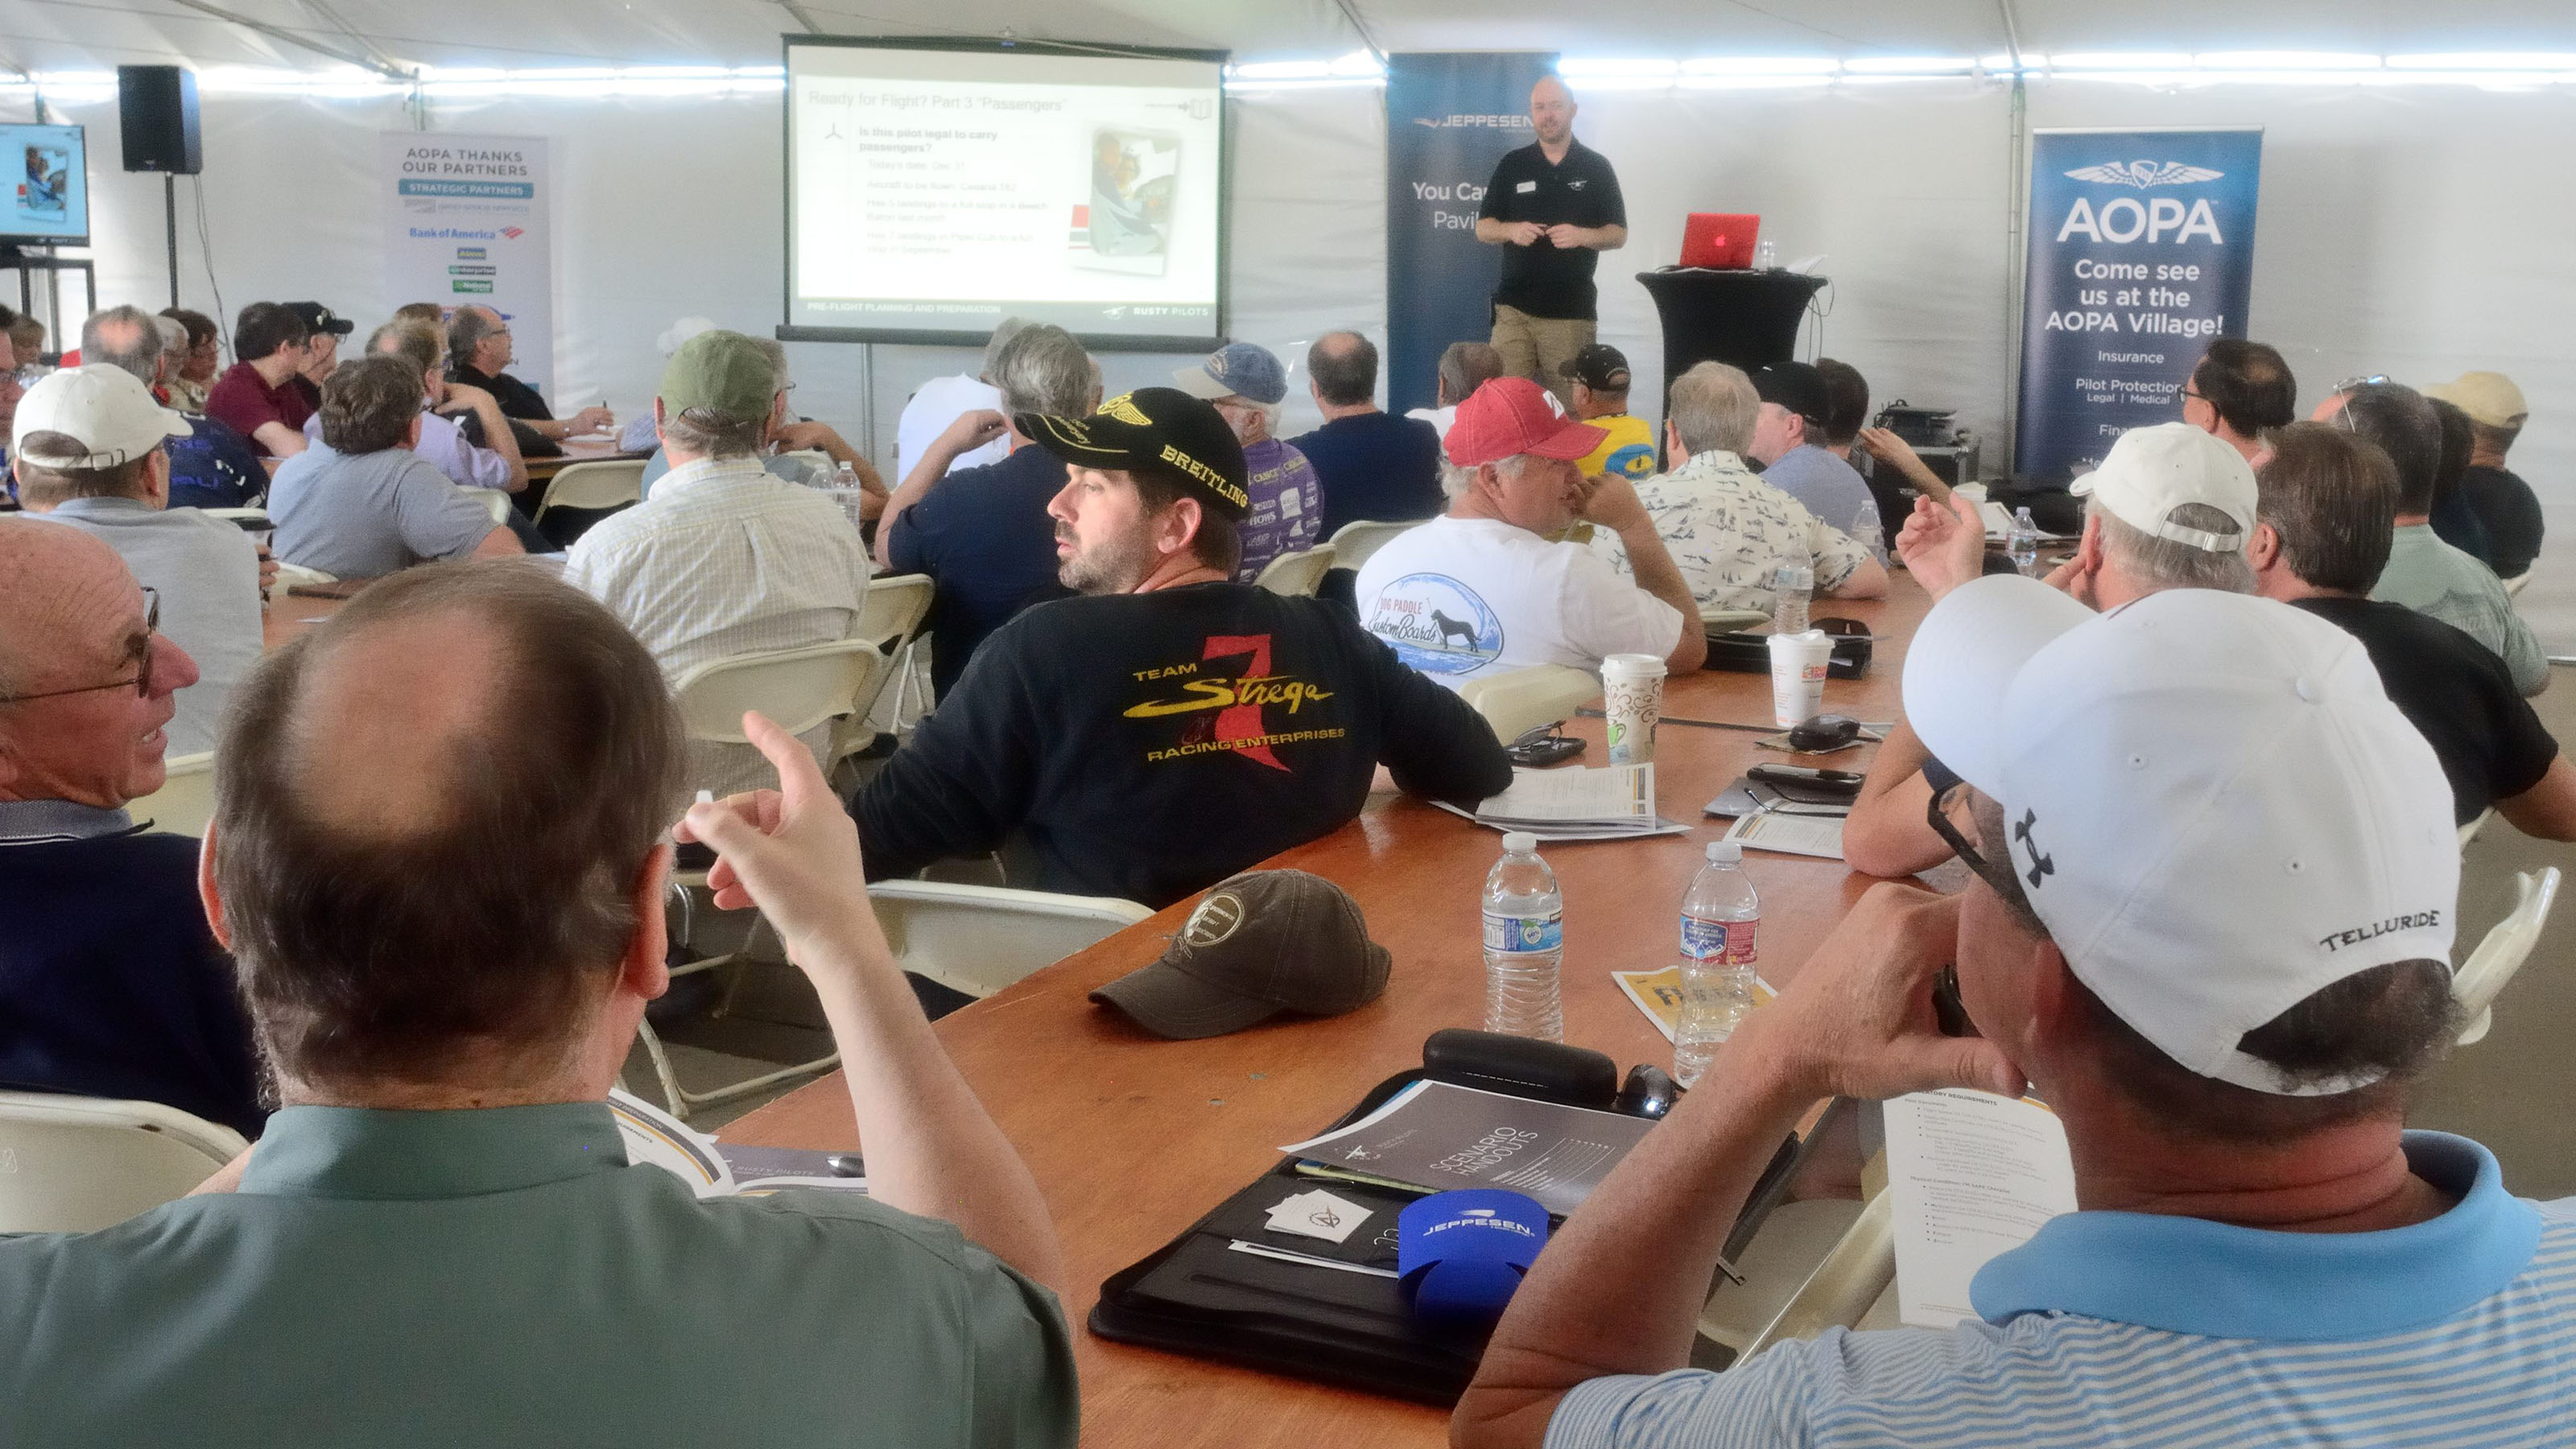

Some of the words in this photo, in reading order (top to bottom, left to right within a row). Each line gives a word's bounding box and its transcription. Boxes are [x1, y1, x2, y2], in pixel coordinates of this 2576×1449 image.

[809, 91, 854, 108] Ready
[858, 93, 876, 105] for
[881, 93, 927, 109] Flight?
[932, 95, 961, 108] Part
[964, 97, 973, 109] 3
[1442, 114, 1534, 127] JEPPESEN
[859, 126, 869, 135] Is
[873, 126, 894, 136] this
[897, 128, 922, 138] pilot
[925, 128, 952, 140] legal
[955, 130, 967, 139] to
[968, 131, 997, 141] carry
[407, 148, 451, 159] AOPA
[457, 149, 522, 163] THANKS
[859, 142, 932, 154] passengers?
[402, 162, 438, 173] OUR
[444, 163, 528, 176] PARTNERS
[409, 184, 467, 194] STRATEGIC
[470, 184, 523, 195] PARTNERS
[1413, 182, 1450, 200] You
[2057, 197, 2223, 244] AOPA
[410, 228, 436, 238] Bank
[439, 228, 450, 237] of
[451, 229, 496, 239] America
[2074, 259, 2148, 280] Come
[2156, 264, 2200, 280] see
[2080, 291, 2107, 306] us
[2116, 288, 2140, 307] at
[2149, 287, 2190, 308] the
[807, 303, 863, 313] PRE-FLIGHT
[865, 303, 913, 313] PLANNING
[914, 304, 935, 314] AND
[936, 304, 1001, 315] PREPARATION
[1133, 307, 1168, 316] RUSTY
[1172, 307, 1208, 316] PILOTS
[2046, 311, 2119, 332] AOPA
[2128, 313, 2223, 338] Village!
[2098, 350, 2165, 363] Insurance
[2076, 378, 2107, 391] Pilot
[2087, 393, 2116, 403] Legal
[2130, 394, 2170, 404] Medical
[1159, 444, 1248, 508] BREITLING
[1393, 598, 1422, 615] PADDLE
[1398, 614, 1437, 642] Boards
[1133, 663, 1197, 682] TEAM
[1123, 675, 1335, 717] Strega
[1148, 741, 1232, 762] RACING
[1236, 728, 1345, 749] ENTERPRISES
[2320, 910, 2440, 952] TELLURIDE
[1948, 1093, 1997, 1106] REQUIREMENTS
[1430, 1127, 1517, 1172] SCENARIO
[1451, 1130, 1538, 1176] HANDOUTS
[1422, 1218, 1530, 1237] JEPPESEN
